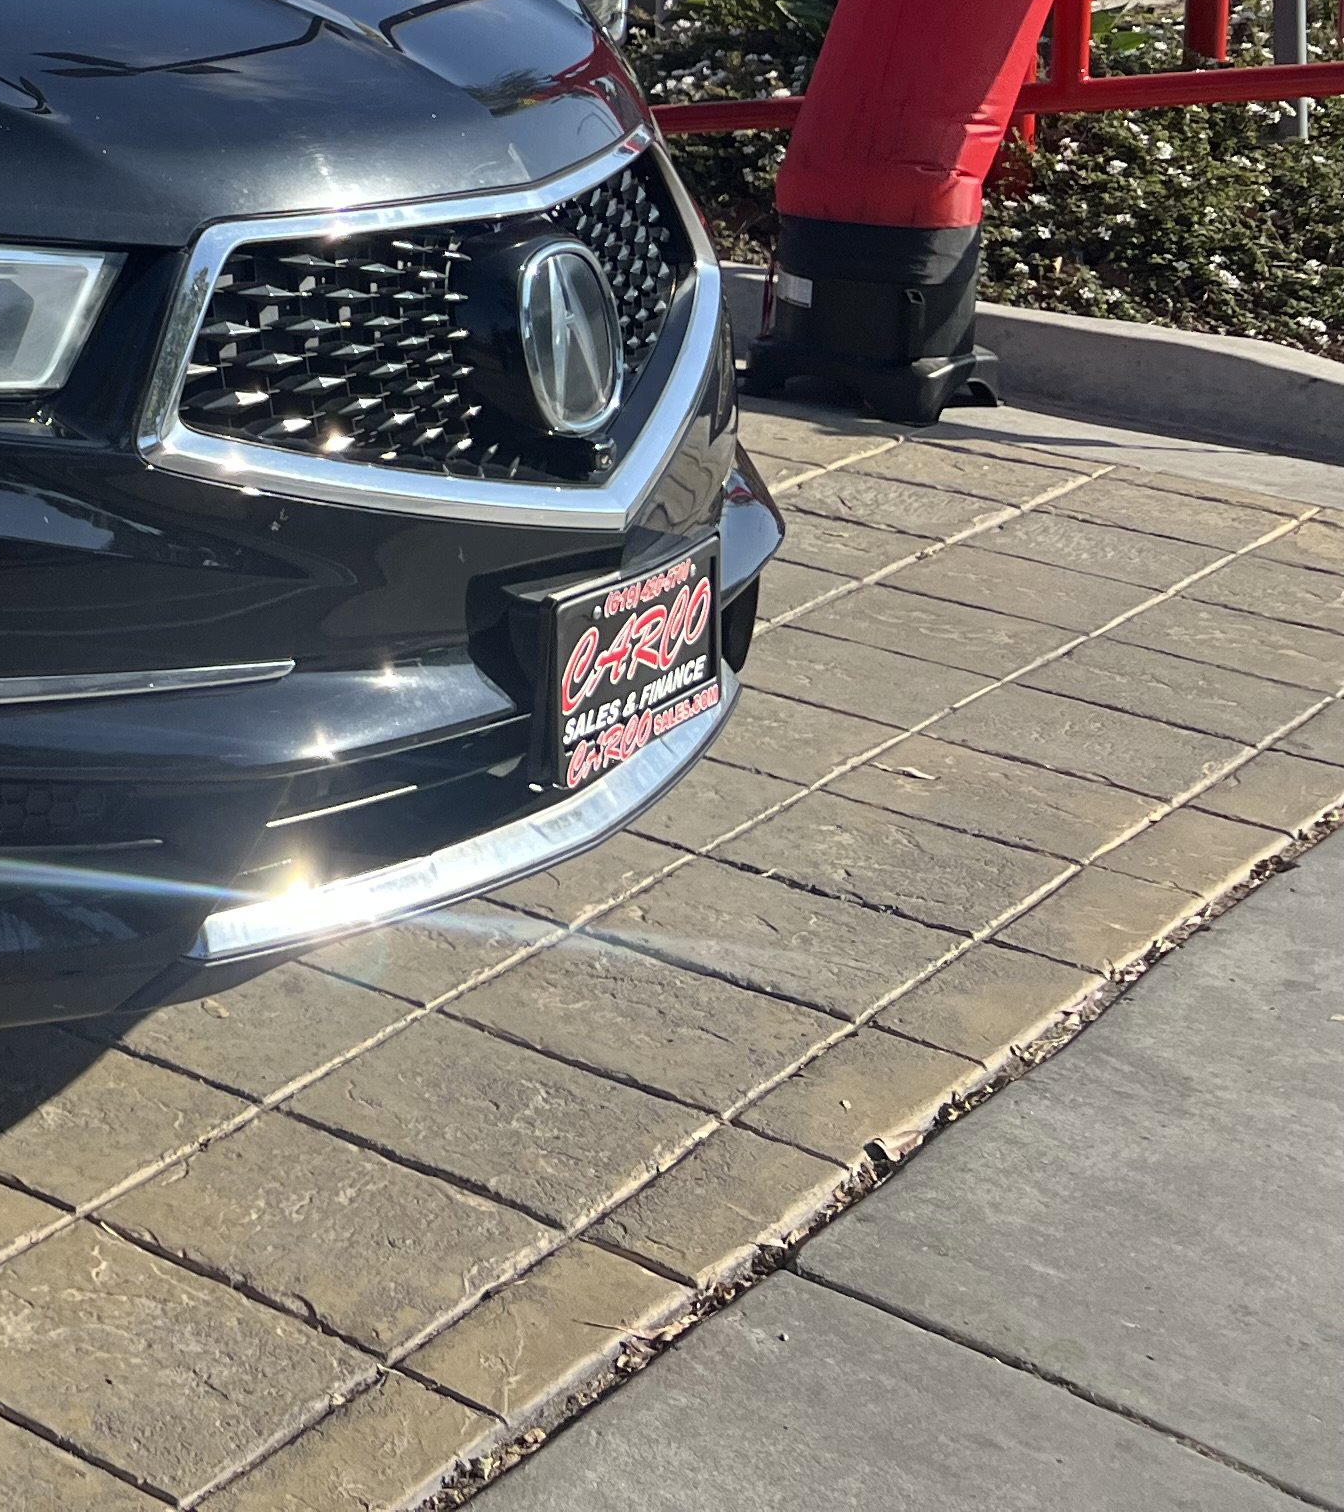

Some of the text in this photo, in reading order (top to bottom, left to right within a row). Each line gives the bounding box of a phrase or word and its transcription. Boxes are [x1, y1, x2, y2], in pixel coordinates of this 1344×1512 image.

[562, 577, 712, 715] CARCO
[563, 654, 708, 745] SALES & FINANCE
[566, 708, 654, 788] CARCO
